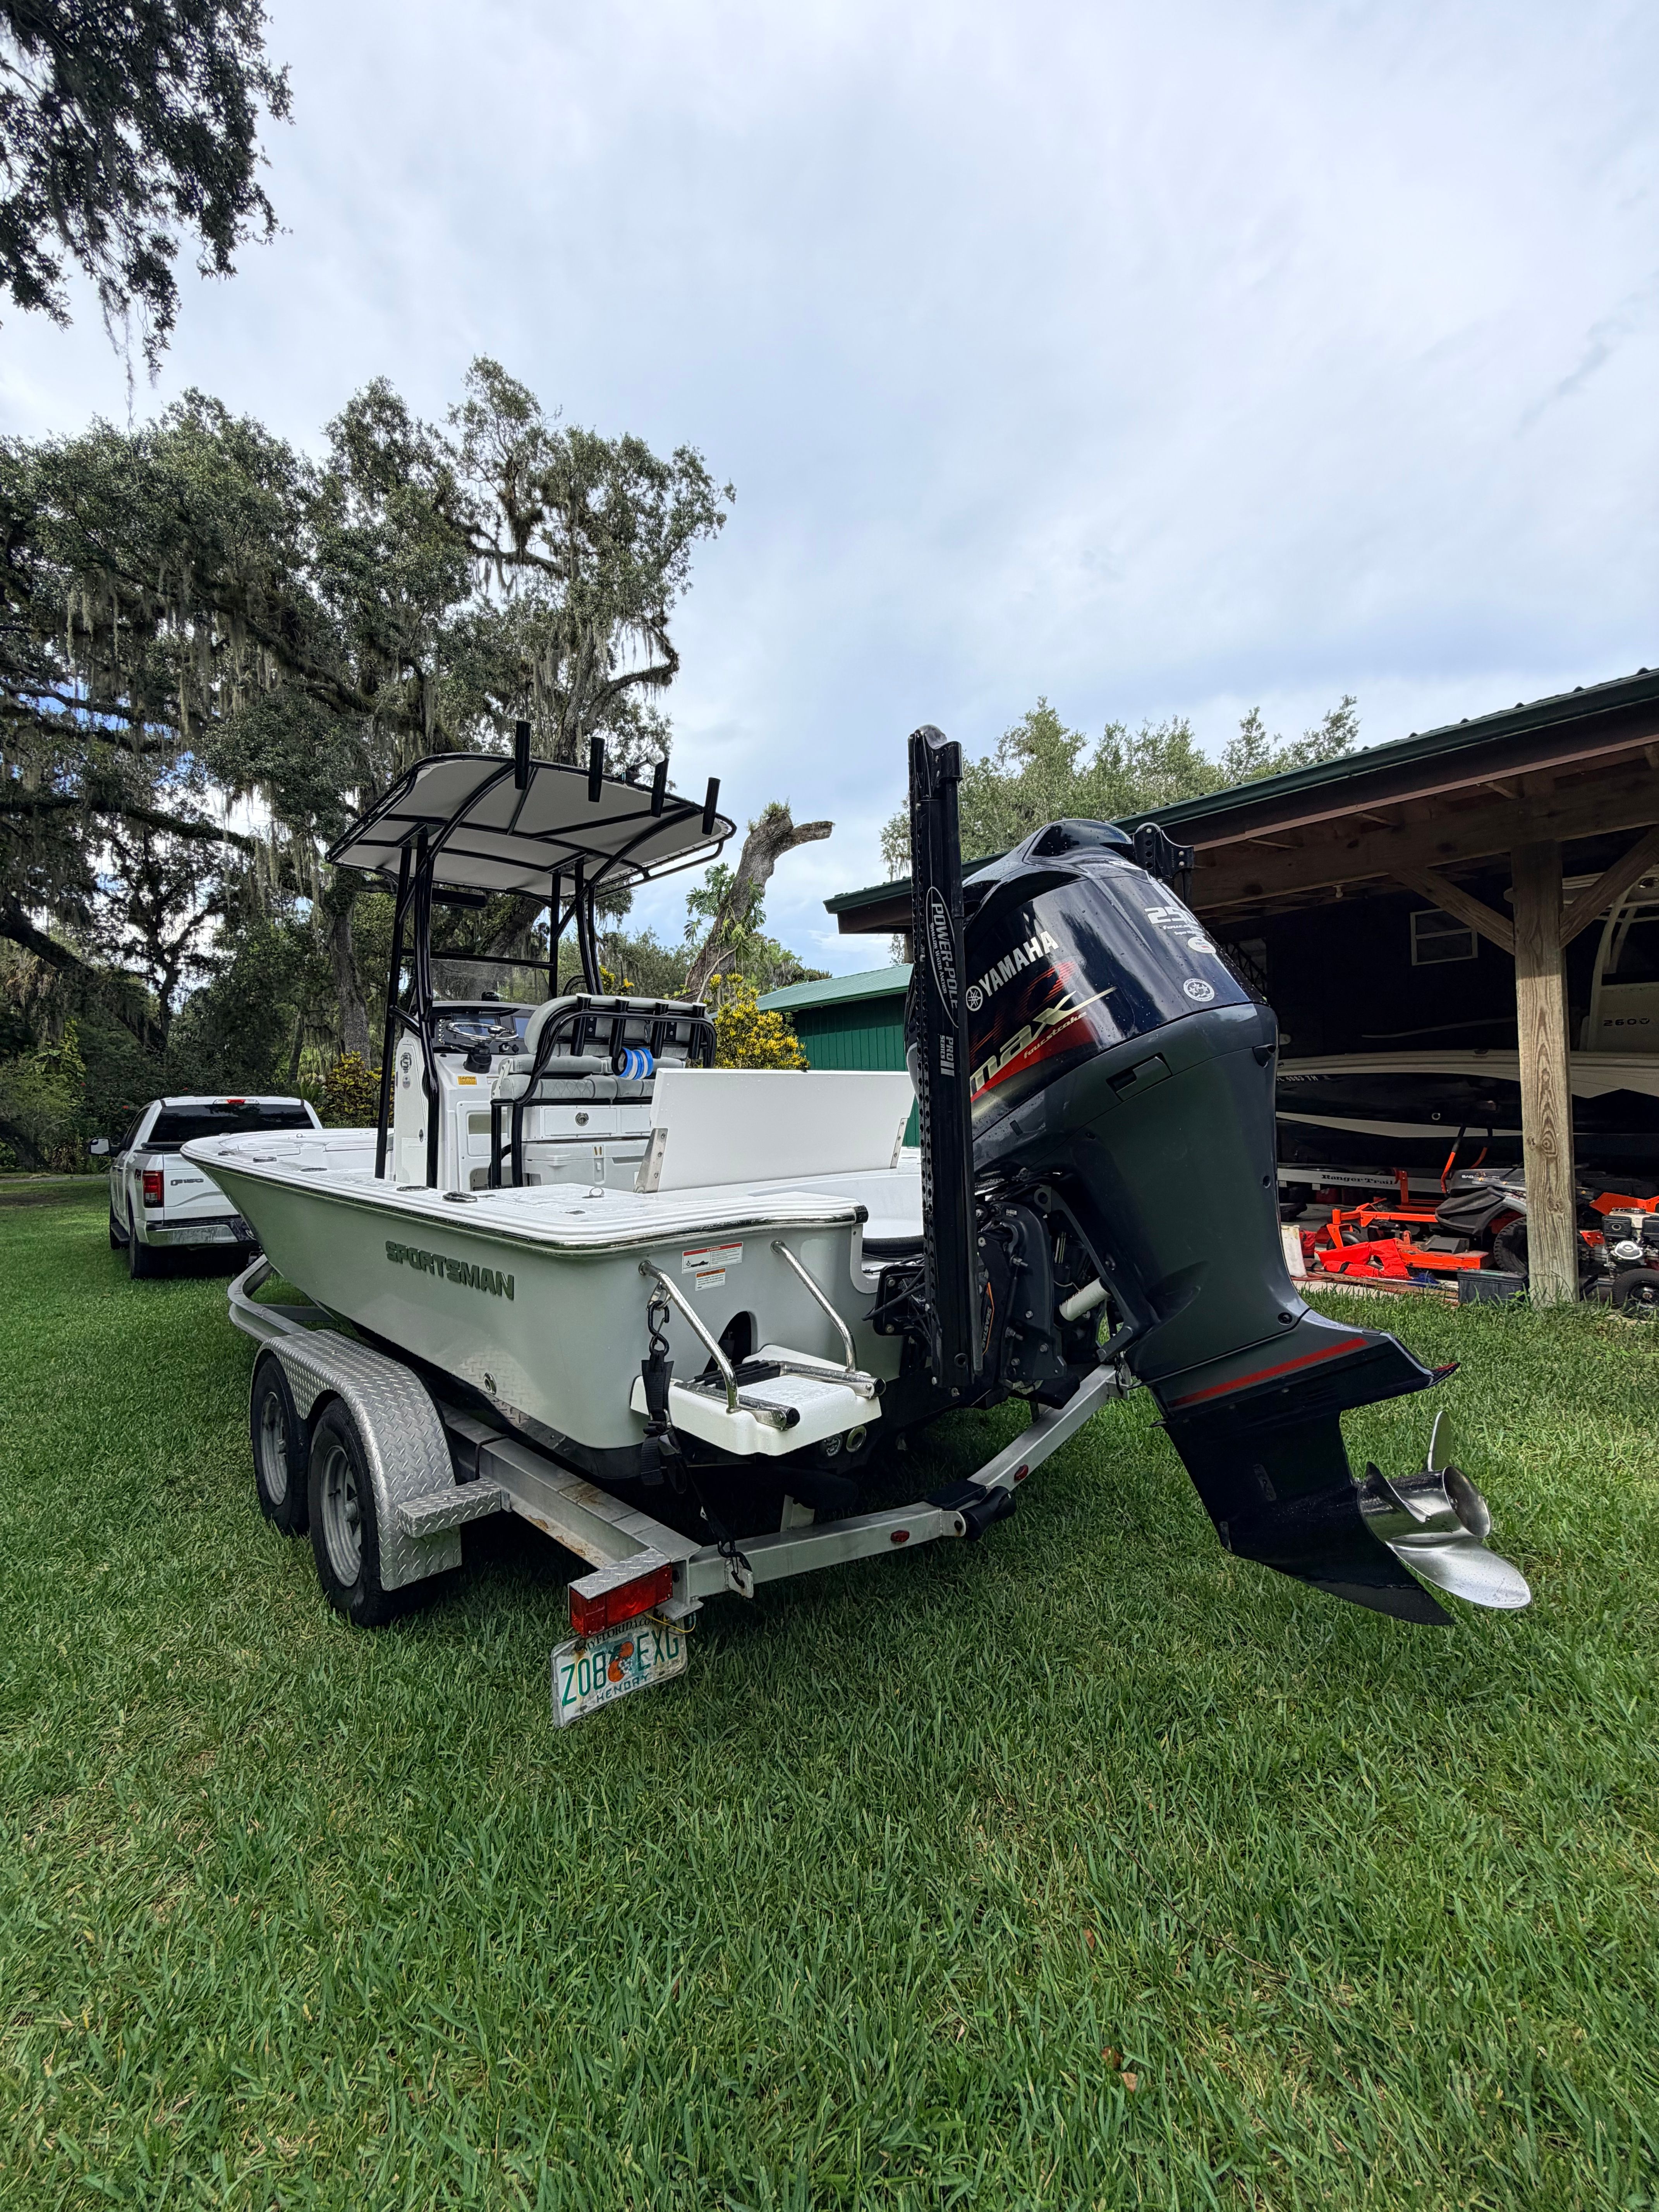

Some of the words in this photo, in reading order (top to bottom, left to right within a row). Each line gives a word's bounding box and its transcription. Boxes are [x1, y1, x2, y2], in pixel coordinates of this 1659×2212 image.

[931, 903, 958, 1009] POWER-POLE
[979, 931, 1059, 997] YAMAHA
[946, 1036, 954, 1061] PRO
[1024, 1011, 1087, 1059] fourstroke
[1603, 1018, 1650, 1026] 2600
[385, 1240, 514, 1301] SPORTSMAN
[561, 1650, 606, 1707] Z08
[637, 1623, 678, 1671] EXG
[596, 1673, 649, 1703] HENDRY
